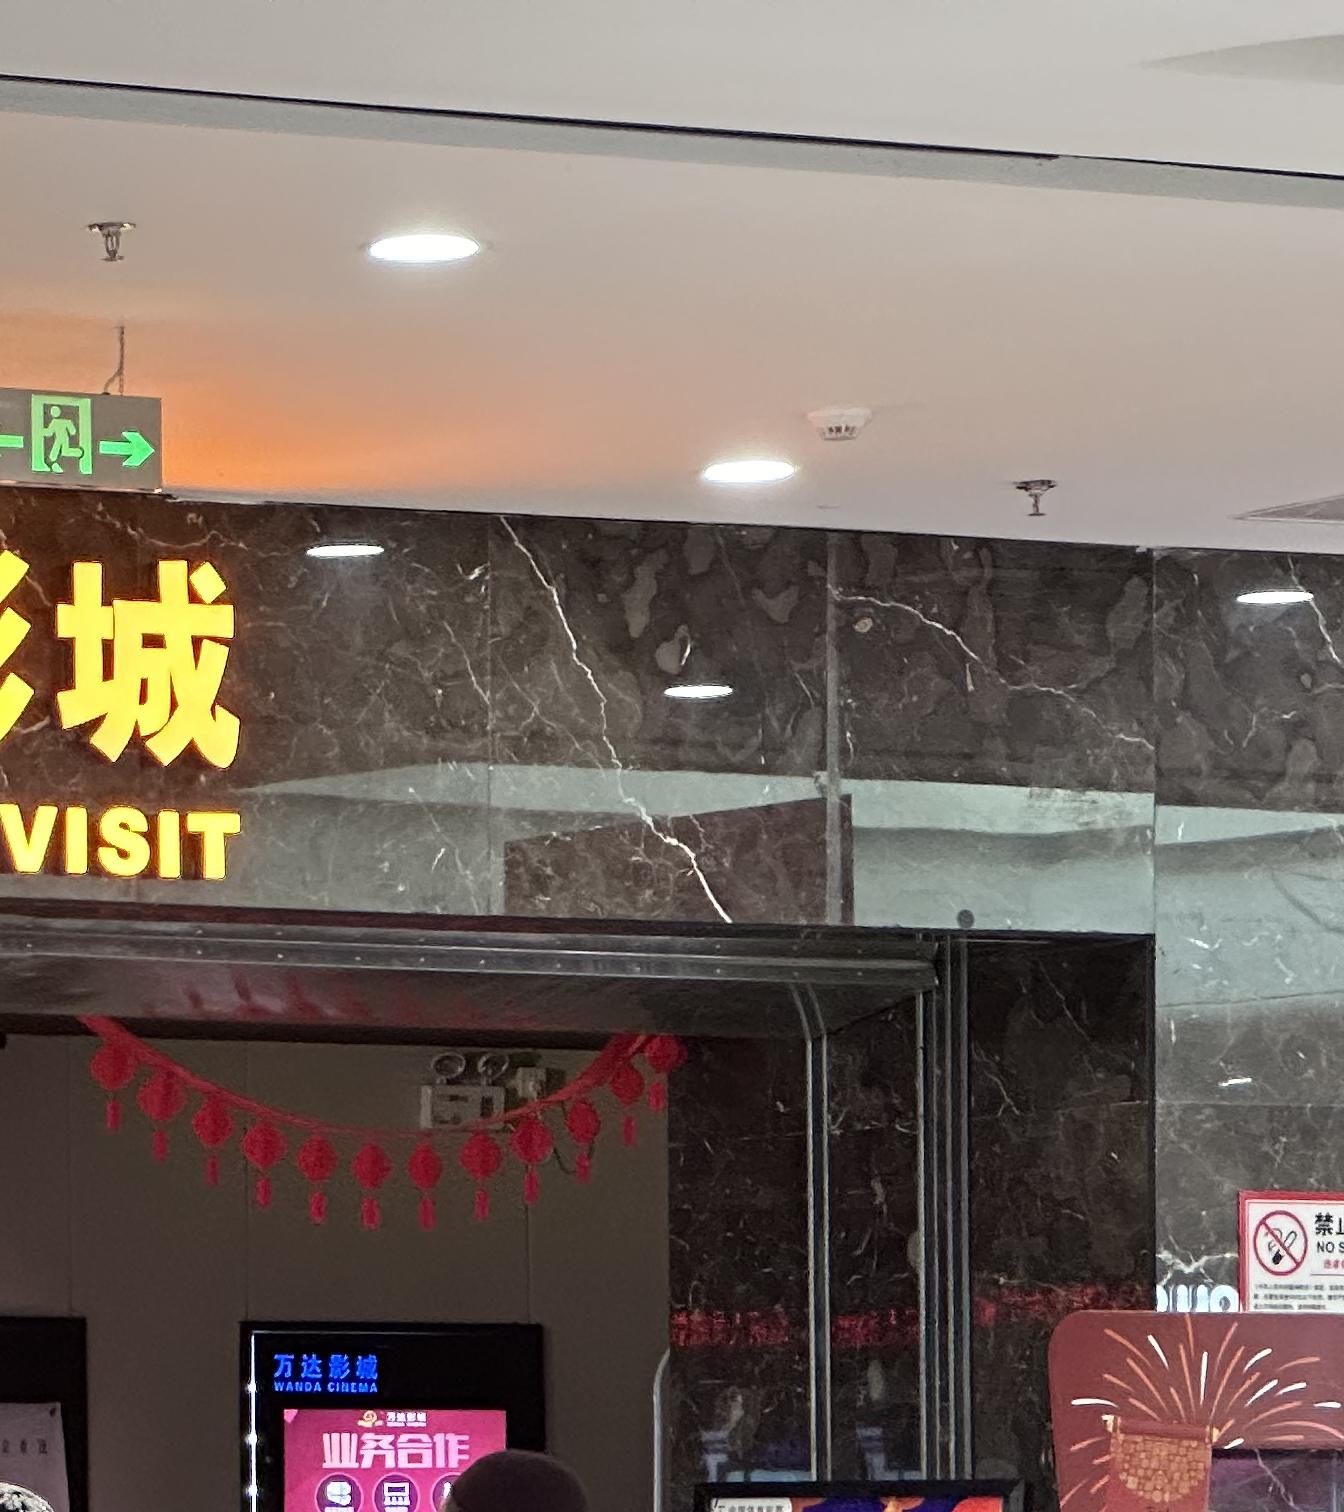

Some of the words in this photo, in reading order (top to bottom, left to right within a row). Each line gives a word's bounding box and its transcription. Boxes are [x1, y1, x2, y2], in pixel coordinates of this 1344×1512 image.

[1317, 1241, 1335, 1254] NO
[273, 1353, 379, 1380] 万达影城
[274, 1381, 322, 1393] WANDA
[327, 1381, 379, 1393] CINEMA
[322, 1432, 470, 1469] 业务合作
